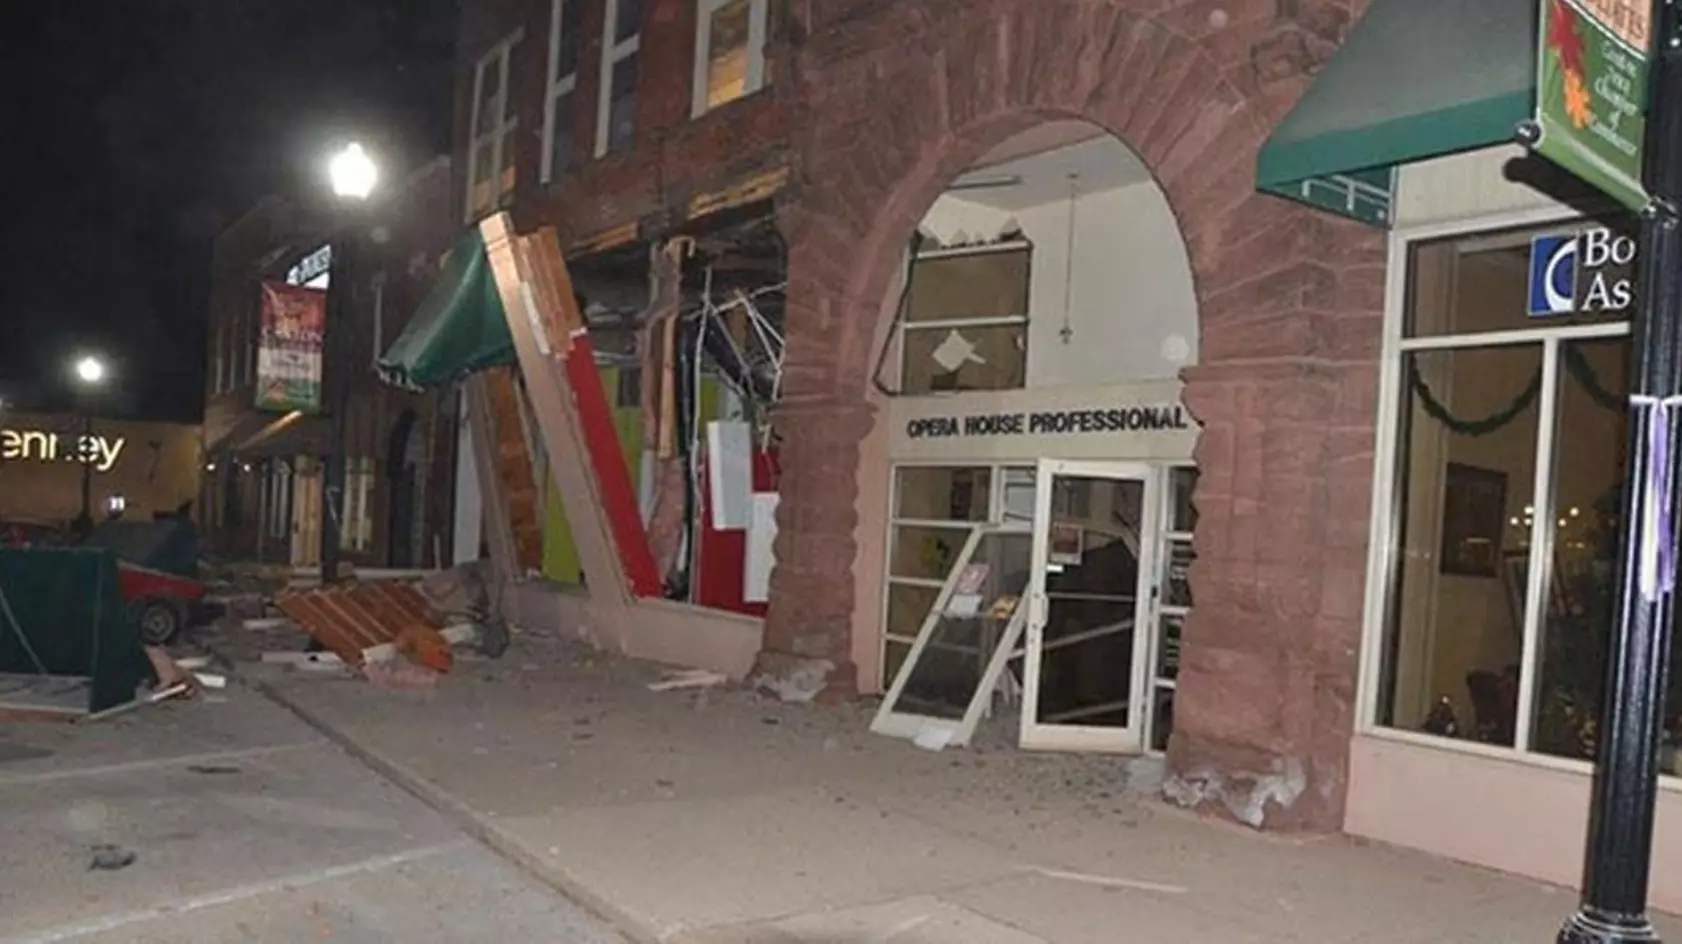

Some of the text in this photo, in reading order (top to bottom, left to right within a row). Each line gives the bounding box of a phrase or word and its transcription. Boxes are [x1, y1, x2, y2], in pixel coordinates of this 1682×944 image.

[1584, 227, 1636, 267] Bo
[1581, 271, 1631, 311] As
[907, 406, 1187, 438] OPERA HOUSE PROFESSIONAL
